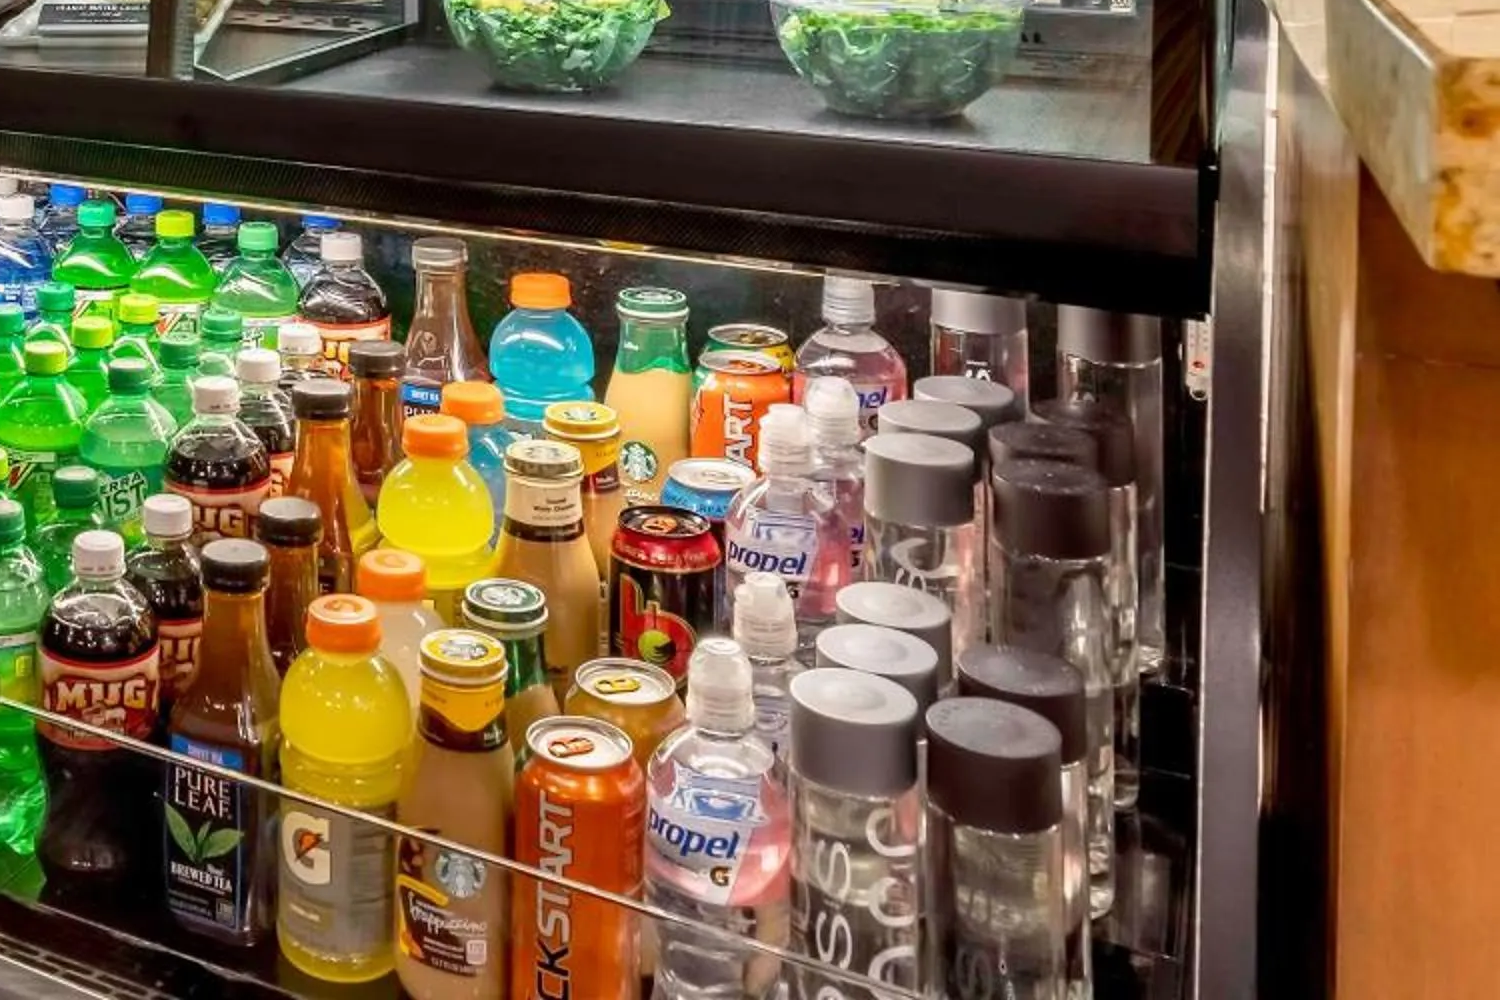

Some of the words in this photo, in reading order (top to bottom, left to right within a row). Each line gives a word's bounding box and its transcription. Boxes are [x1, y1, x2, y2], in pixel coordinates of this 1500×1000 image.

[100, 472, 143, 496] ERRA
[103, 480, 147, 520] IST
[192, 505, 245, 537] UG
[728, 540, 808, 576] propel
[55, 677, 148, 712] MUG
[174, 766, 232, 800] PURE
[174, 784, 233, 820] LEAF
[282, 810, 332, 885] G
[648, 807, 741, 860] propel
[709, 865, 733, 887] G
